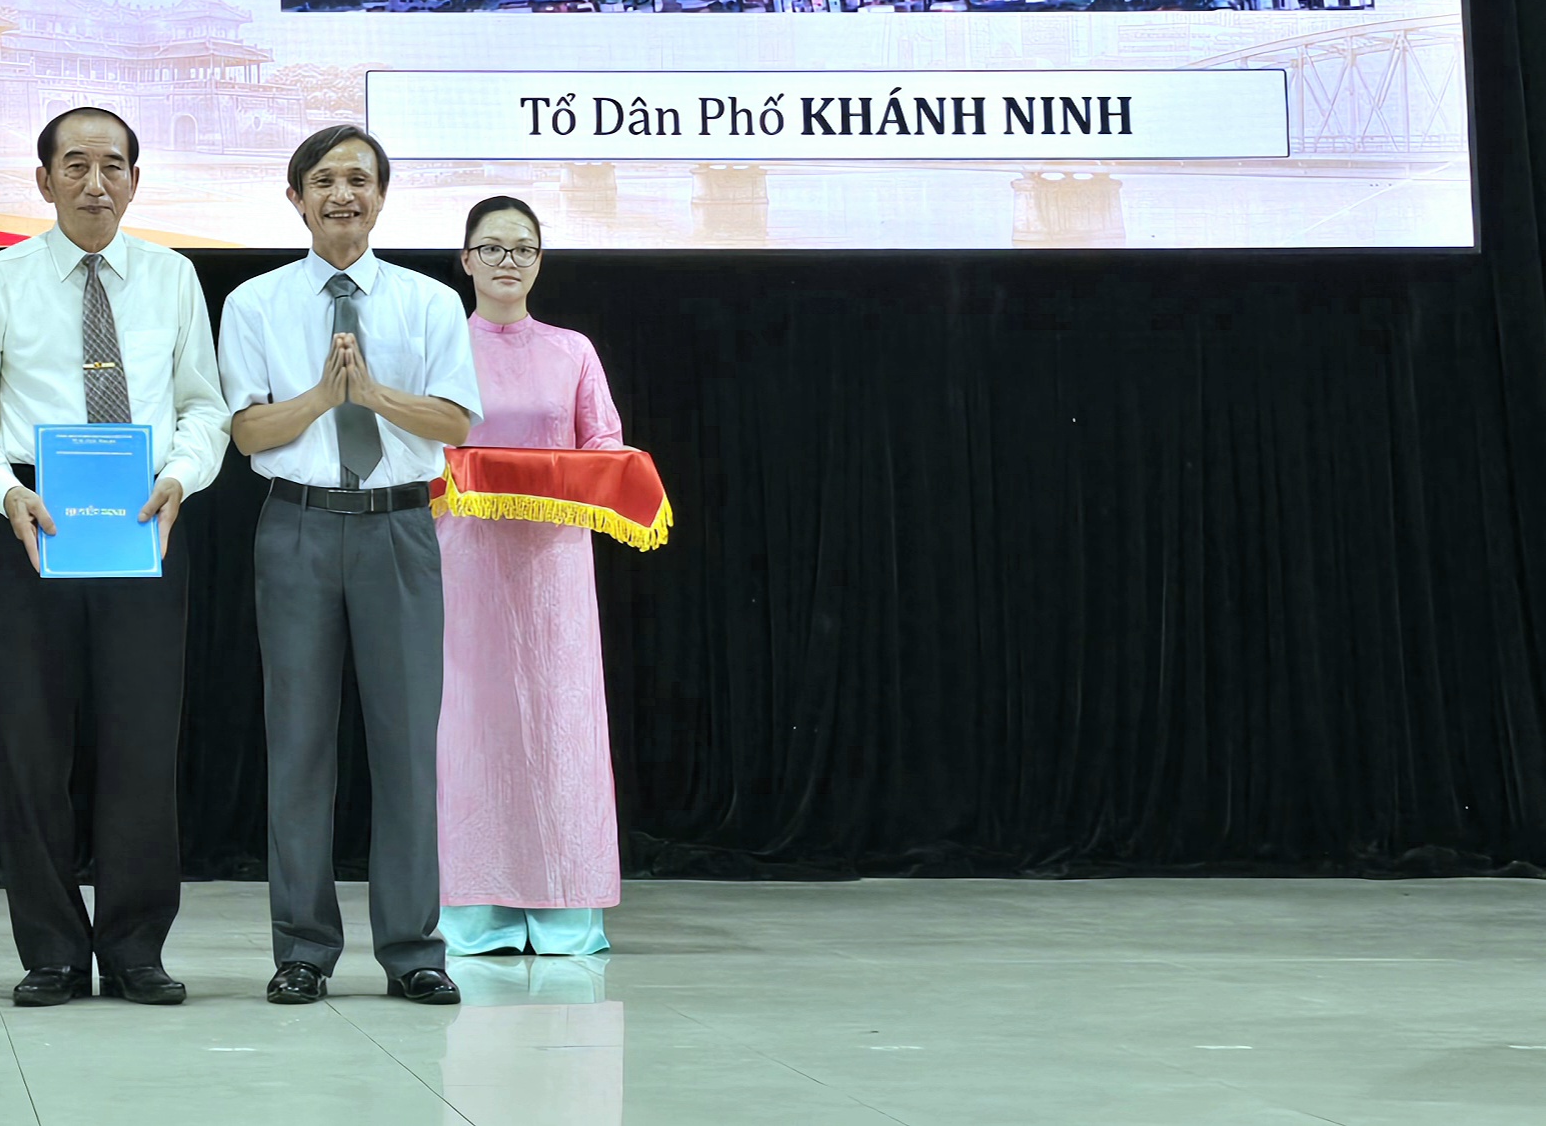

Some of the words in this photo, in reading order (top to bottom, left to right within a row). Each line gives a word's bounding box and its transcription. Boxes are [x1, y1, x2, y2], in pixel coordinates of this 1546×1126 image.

[520, 92, 576, 136] Tổ
[592, 95, 682, 136] Dân
[698, 91, 785, 136] Phố
[800, 86, 987, 136] KHÁNH
[1002, 96, 1133, 135] NINH
